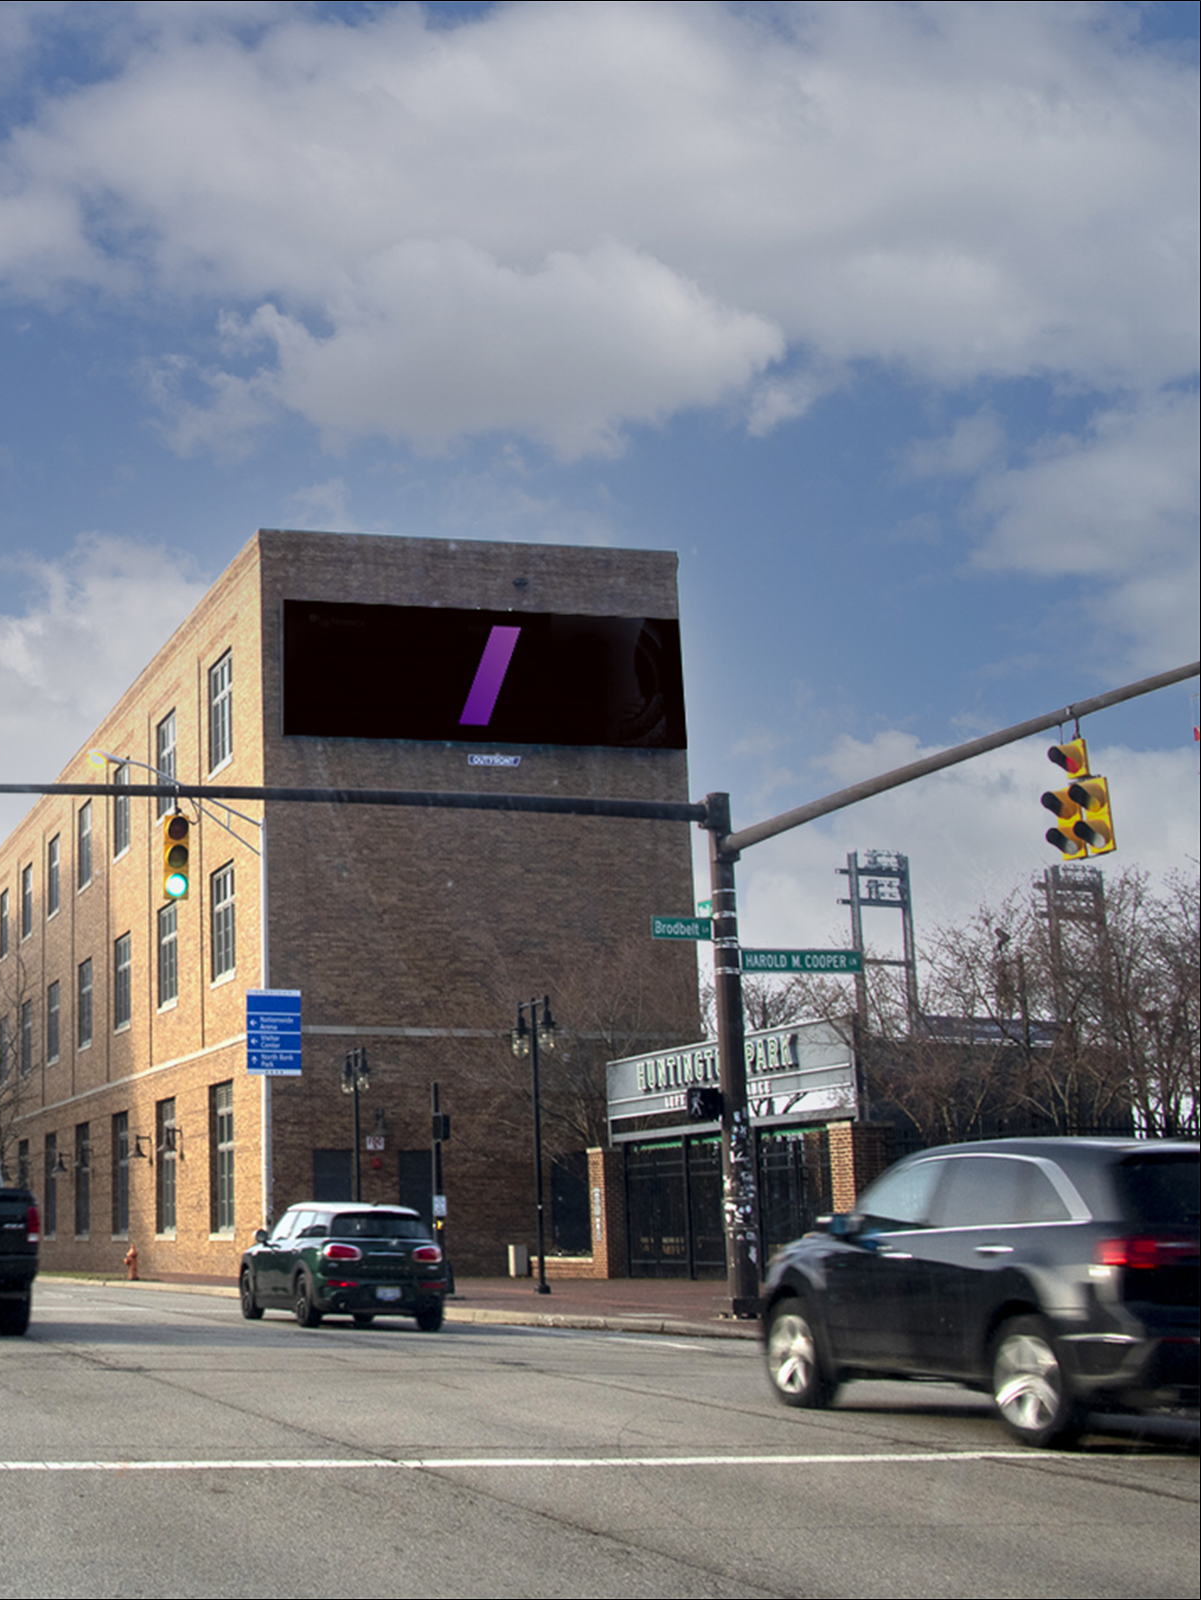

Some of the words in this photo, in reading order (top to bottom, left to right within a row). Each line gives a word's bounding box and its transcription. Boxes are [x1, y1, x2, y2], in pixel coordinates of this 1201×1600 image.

[654, 921, 700, 936] Brodbelt
[745, 955, 787, 968] HAROLD
[791, 956, 802, 969] M.
[804, 956, 847, 969] COOPER
[260, 1016, 294, 1024] Nationwide
[261, 1053, 278, 1061] North
[280, 1053, 294, 1061] Bank
[744, 1033, 794, 1072] PARK
